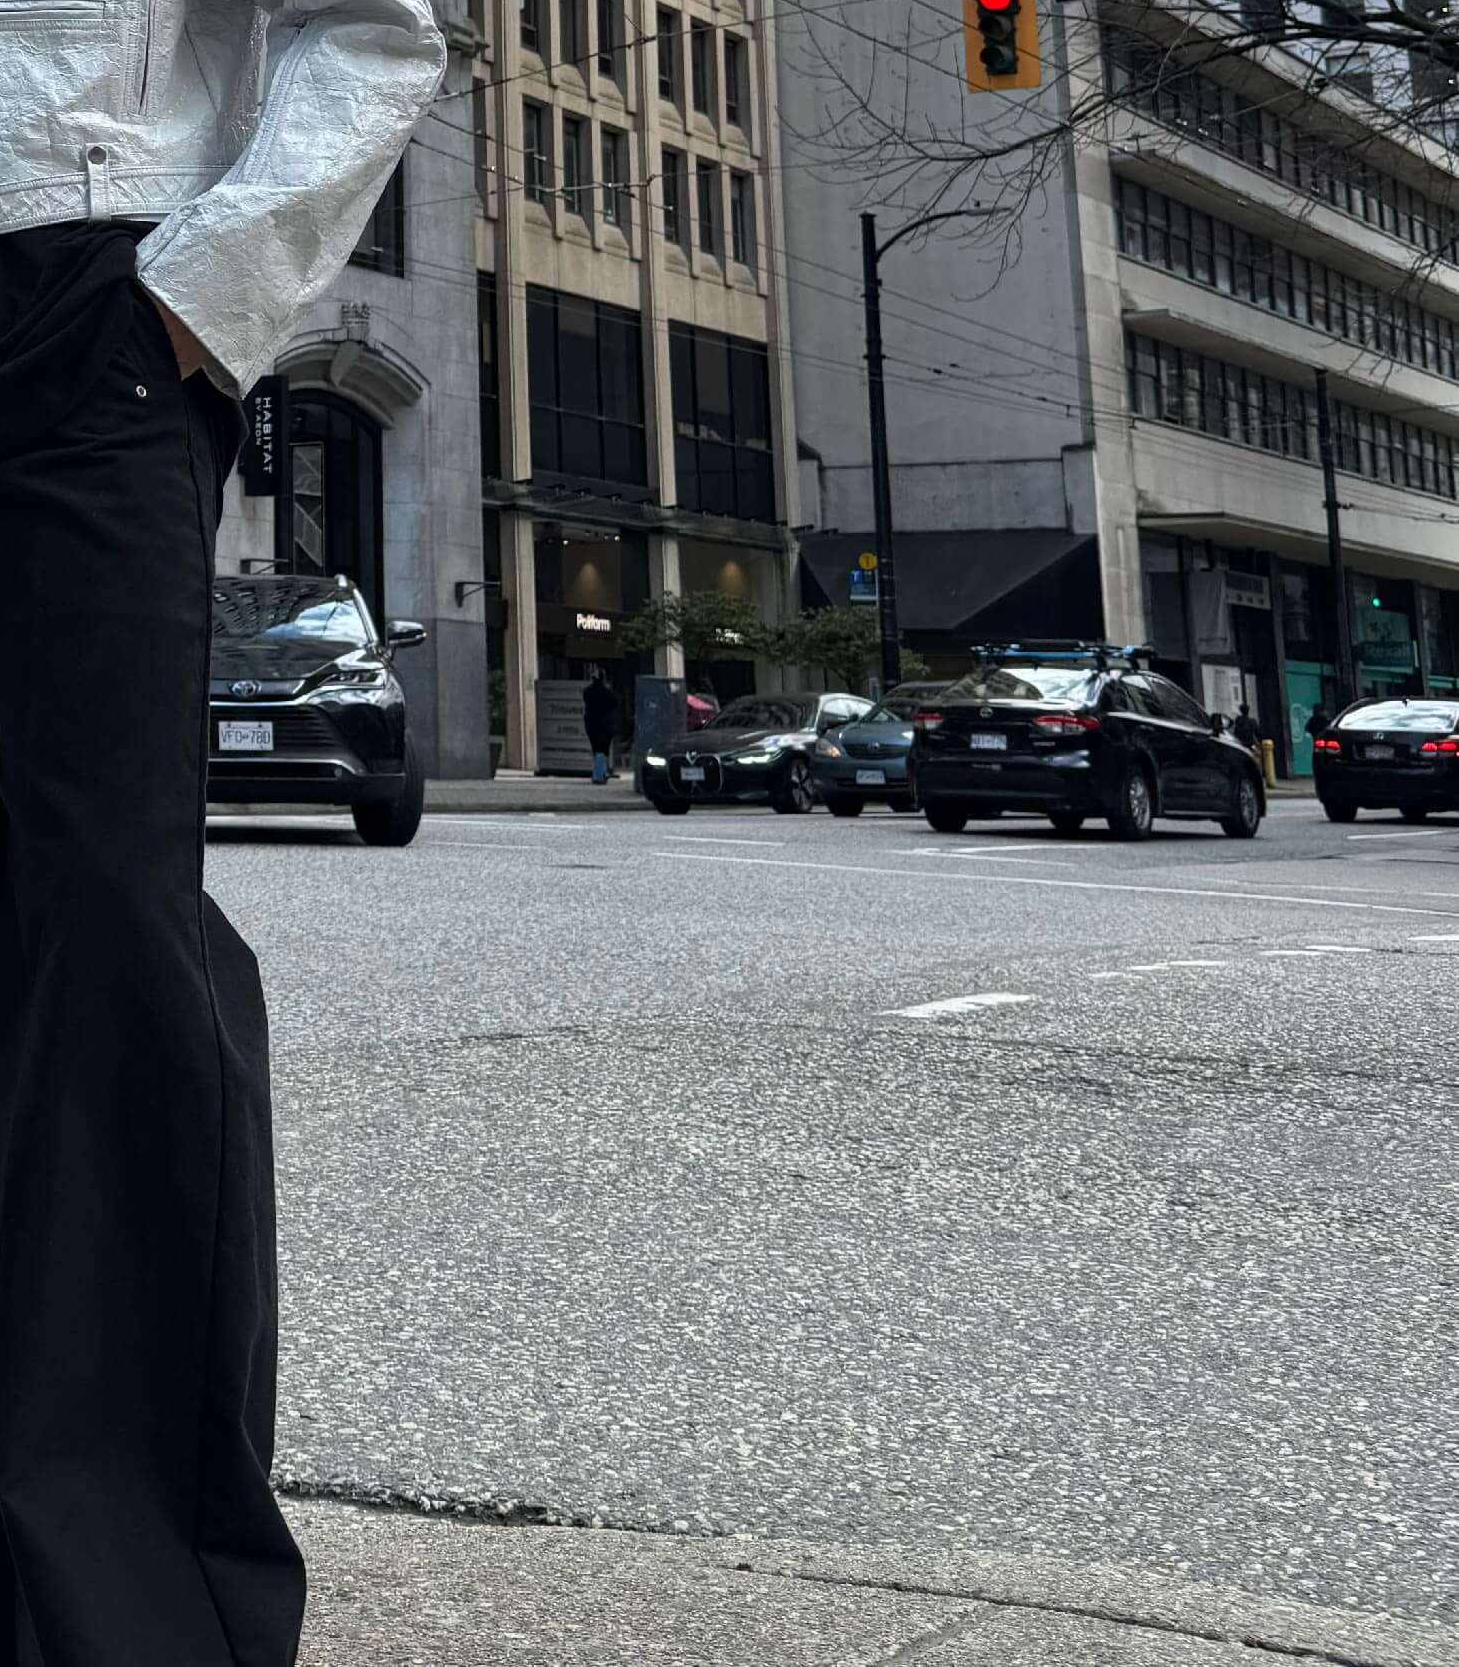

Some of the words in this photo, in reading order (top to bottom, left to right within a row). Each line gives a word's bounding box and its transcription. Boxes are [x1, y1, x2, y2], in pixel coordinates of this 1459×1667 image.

[254, 397, 262, 412] BY
[254, 414, 262, 446] AEON
[262, 397, 273, 474] HABITAT
